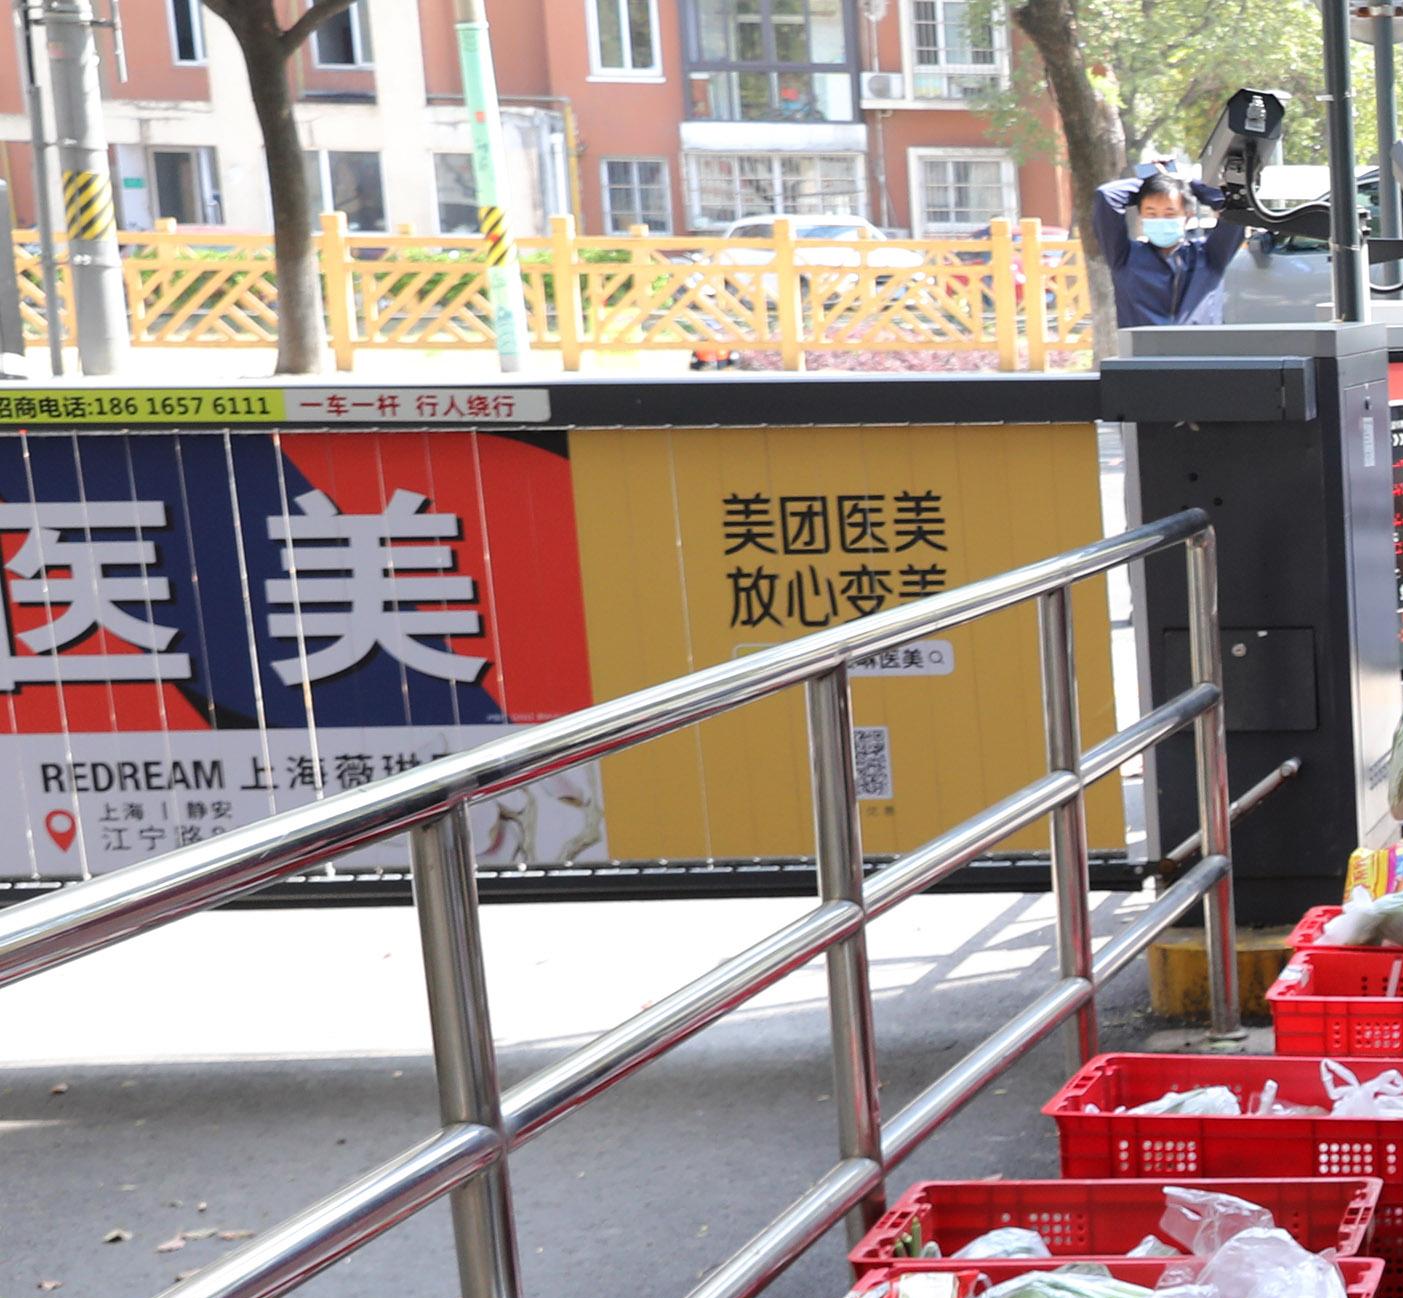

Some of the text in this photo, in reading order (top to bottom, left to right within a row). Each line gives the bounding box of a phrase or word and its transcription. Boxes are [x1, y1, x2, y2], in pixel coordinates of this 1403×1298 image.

[146, 397, 203, 415] 1657
[212, 396, 271, 415] 6111
[299, 395, 516, 418] 一车一杆 行人绕行
[722, 490, 948, 556] 美团医美
[0, 488, 492, 694] 医美
[41, 760, 226, 793] REDREAM
[99, 801, 233, 822] 上海 静安
